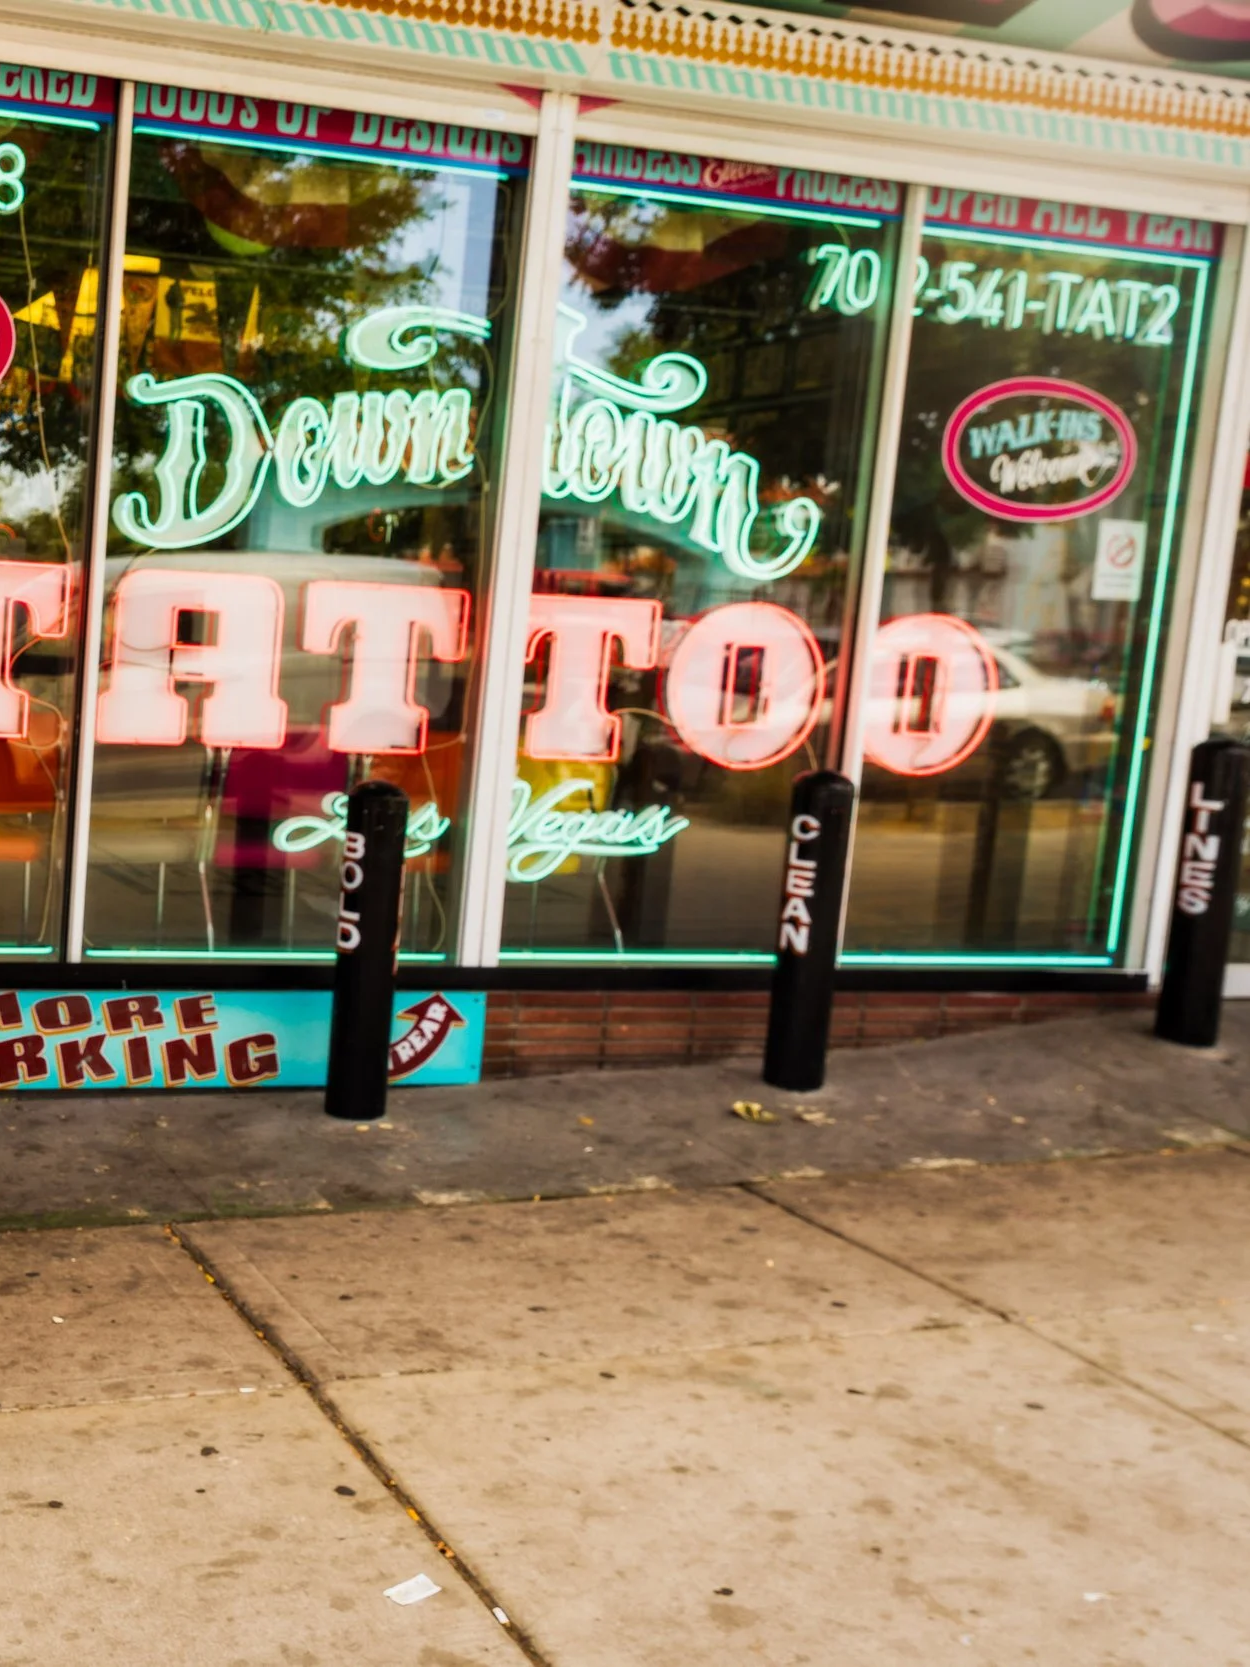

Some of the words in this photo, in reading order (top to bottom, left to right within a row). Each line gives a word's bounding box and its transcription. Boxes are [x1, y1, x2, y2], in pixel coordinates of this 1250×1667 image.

[1031, 200, 1111, 239] ALL
[506, 777, 690, 883] Vegas
[778, 814, 821, 954] CLEAN
[1178, 781, 1224, 915] LINES
[337, 831, 366, 951] BOLD
[393, 1001, 449, 1065] REAR
